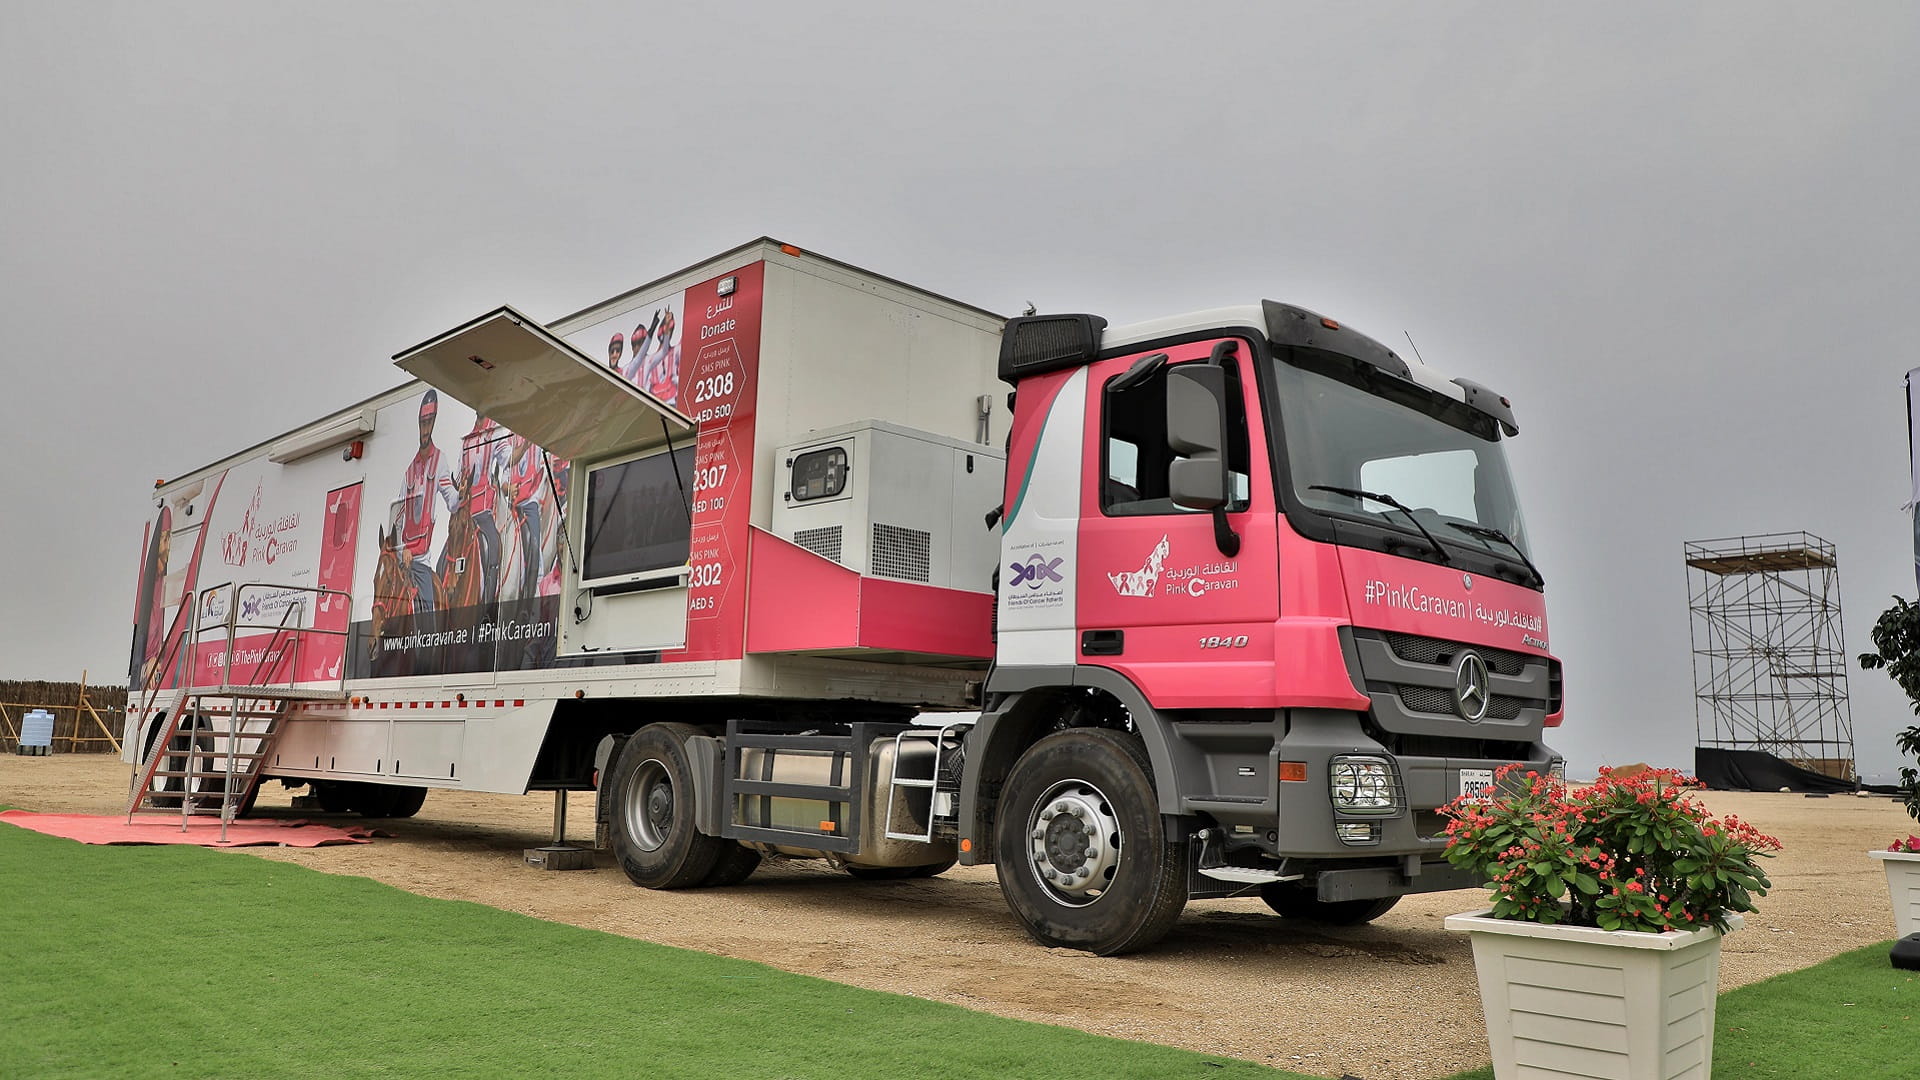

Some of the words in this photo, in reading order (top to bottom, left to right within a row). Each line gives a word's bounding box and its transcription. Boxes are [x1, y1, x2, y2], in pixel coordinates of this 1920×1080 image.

[706, 296, 733, 319] للتبرع
[701, 319, 736, 339] Donate
[700, 362, 715, 375] SMS
[715, 358, 730, 372] PINK
[695, 371, 734, 403] 2308
[695, 409, 713, 423] AED
[714, 403, 731, 418] 500
[695, 454, 709, 466] SMS
[709, 451, 725, 464] PINK
[692, 464, 727, 492] 2307
[691, 500, 707, 513] AED
[710, 497, 724, 510] 100
[252, 547, 266, 563] Pink
[266, 537, 298, 566] Caravan
[690, 550, 703, 562] SMS
[703, 547, 719, 560] PINK
[688, 562, 722, 588] 2302
[1166, 565, 1200, 580] الوردية
[1202, 561, 1238, 575] القافلة
[1166, 583, 1187, 595] Pink
[1188, 578, 1238, 597] Caravan
[690, 597, 706, 611] AED
[708, 596, 714, 609] 5
[1365, 579, 1466, 618] #PinkCaravan
[383, 629, 468, 654] www.pinkcaravan.ae
[478, 620, 551, 643] #PinkCaravan
[1199, 635, 1249, 649] 1840
